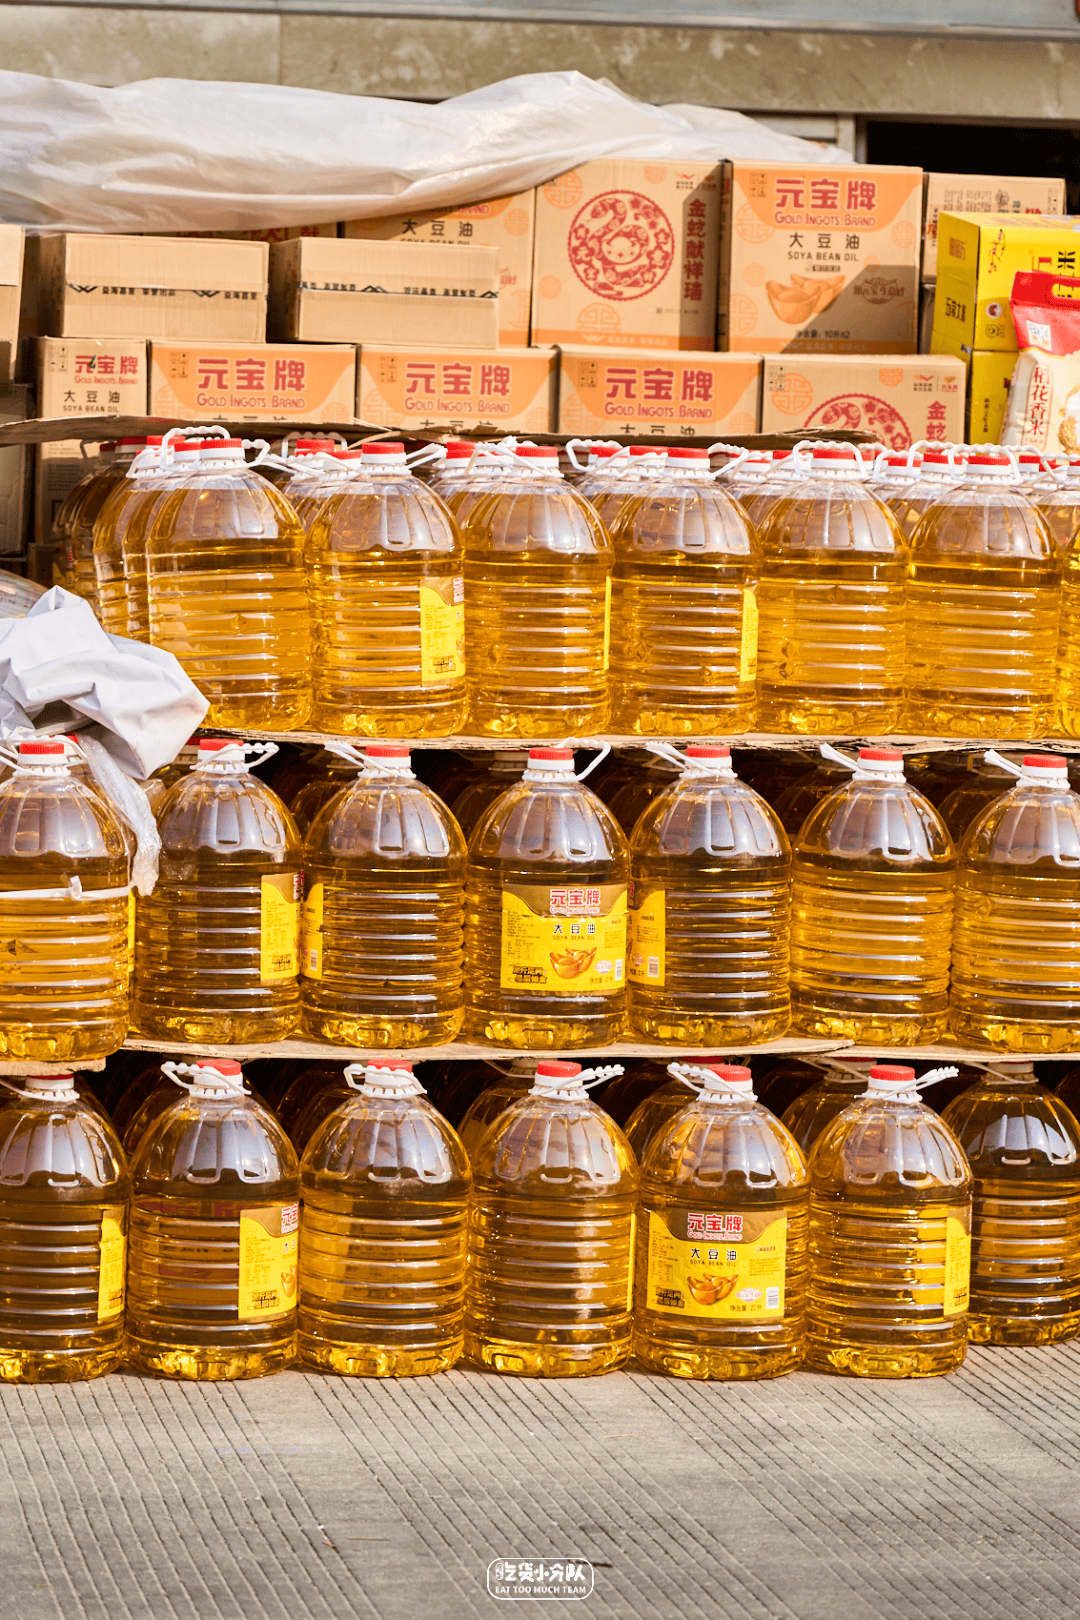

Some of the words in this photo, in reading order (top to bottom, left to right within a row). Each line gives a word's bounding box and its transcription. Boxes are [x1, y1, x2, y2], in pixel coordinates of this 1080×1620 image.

[776, 178, 876, 210] 元宝牌
[774, 211, 802, 224] GOLD
[805, 212, 840, 226] INGOTS
[844, 213, 876, 227] BRAND
[402, 219, 473, 237] 大豆油
[789, 232, 859, 249] 大豆油
[787, 251, 813, 260] SOYA
[816, 252, 841, 261] BEAN
[844, 253, 859, 262] OIL
[75, 355, 138, 375] 元宝牌
[198, 357, 305, 391] 元宝牌
[406, 362, 510, 396] 元宝牌
[606, 367, 713, 402] 元宝牌
[64, 390, 120, 403] 大豆油
[197, 392, 227, 407] GOLD
[230, 393, 267, 408] INGOTS
[271, 394, 305, 409] BRAND
[404, 396, 434, 411] GOLD
[437, 398, 473, 413] INGOTS
[478, 399, 510, 413] BRAND
[85, 405, 105, 413] BEAN
[604, 401, 635, 416] GOLD
[638, 402, 674, 418] INGOTS
[679, 404, 713, 419] BRAND
[551, 889, 600, 905] 元宝牌
[553, 923, 596, 935] 大豆油
[688, 1213, 742, 1232] 元宝牌
[690, 1247, 737, 1261] 大豆油
